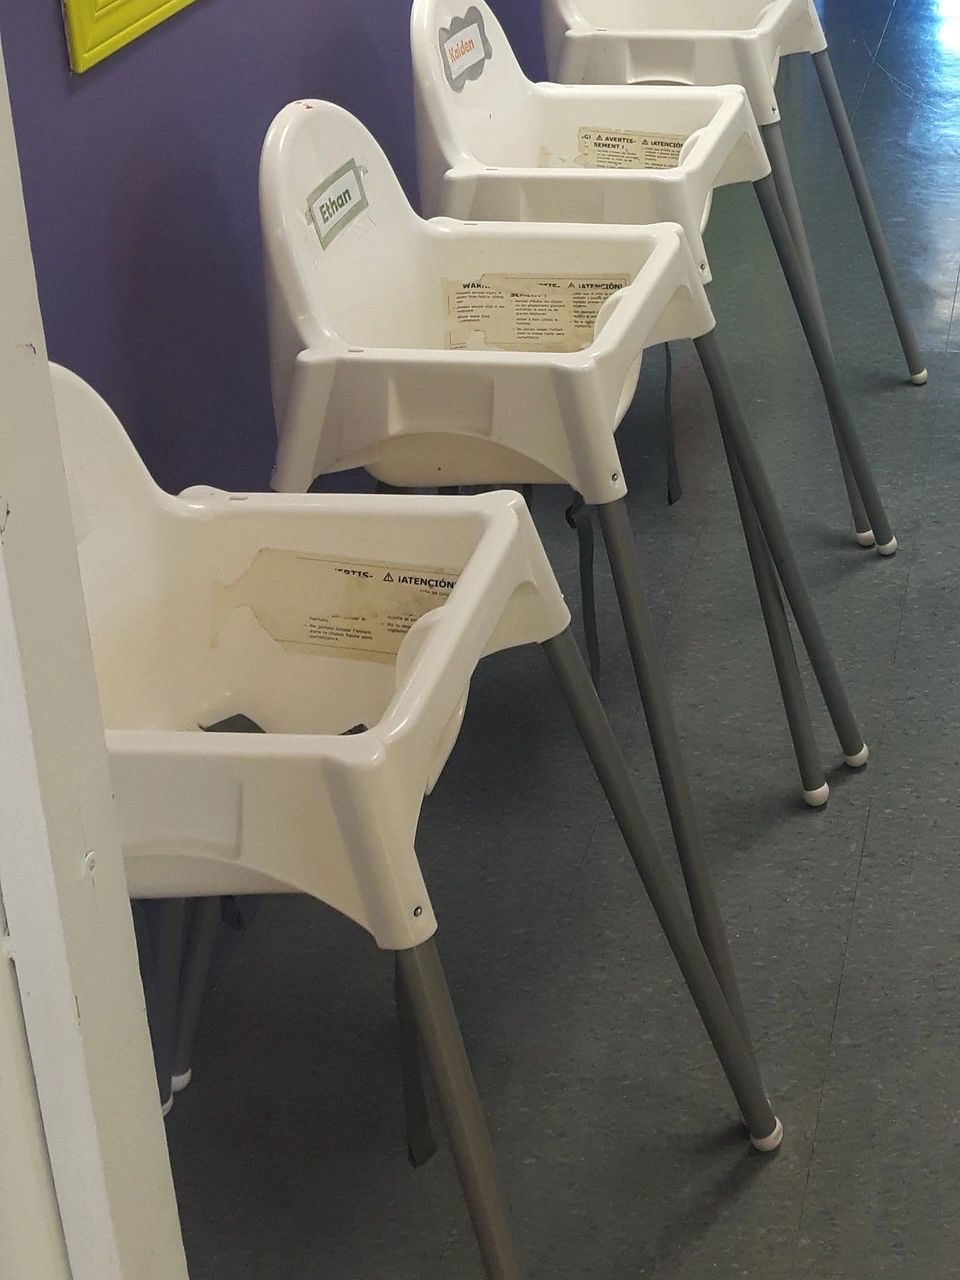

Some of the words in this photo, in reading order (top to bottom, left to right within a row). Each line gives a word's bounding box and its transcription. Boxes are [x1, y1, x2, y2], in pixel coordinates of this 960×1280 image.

[448, 38, 475, 64] Kaiden
[593, 141, 620, 149] SEMENT
[318, 188, 352, 225] Ethan
